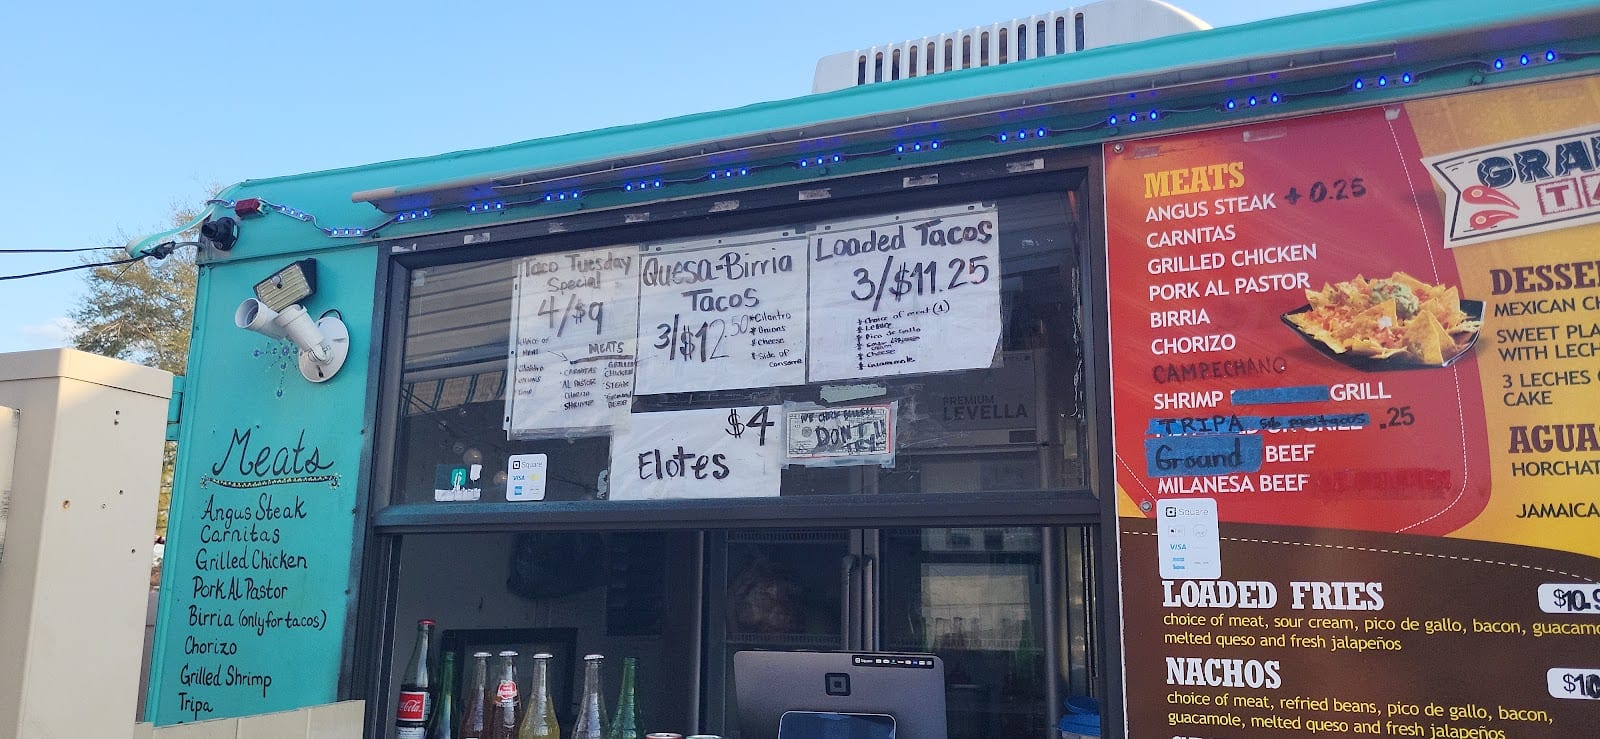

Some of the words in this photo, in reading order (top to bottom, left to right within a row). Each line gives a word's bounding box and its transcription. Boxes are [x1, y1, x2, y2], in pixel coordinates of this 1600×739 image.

[1144, 161, 1245, 198] MEATS
[1309, 178, 1367, 204] 0.25
[1145, 201, 1209, 223] ANGUS
[1214, 192, 1277, 215] STEAK
[816, 225, 906, 262] Loaded
[912, 218, 992, 247] Tacos
[1146, 224, 1236, 249] CARNITAS
[521, 257, 559, 277] Taco
[564, 252, 631, 275] Tuesday
[643, 248, 793, 287] Quesa-Birria
[1147, 252, 1225, 275] GRILLED
[1231, 243, 1318, 267] CHICKEN
[547, 271, 601, 295] Special
[851, 255, 990, 312] 3/$11.25
[1149, 281, 1201, 302] PORK
[1204, 278, 1230, 298] AL
[1235, 272, 1311, 294] PASTOR
[1490, 260, 1600, 296] DESSE
[680, 288, 760, 312] Tacos
[1494, 297, 1576, 318] MEXICAN
[538, 293, 605, 338] 4/$9
[1150, 308, 1210, 329] BIRRIA
[1151, 333, 1236, 355] CHORIZO
[1496, 325, 1560, 344] SWEET
[588, 341, 625, 355] MEATS
[1498, 346, 1549, 363] WITH
[1153, 356, 1287, 384] CAMPECHANO
[1502, 374, 1513, 389] 3
[1520, 370, 1591, 388] LECHES
[1153, 391, 1224, 410] SHRIMP
[1329, 381, 1392, 402] GRILL
[1503, 390, 1553, 407] CAKE
[943, 404, 1028, 420] LEVELLA
[1157, 414, 1244, 434] TRIPA
[725, 406, 775, 447] $4
[1508, 423, 1600, 454] AGUA
[212, 428, 334, 477] Meats
[638, 446, 730, 480] Elotes
[1156, 437, 1244, 471] Ground
[1265, 444, 1316, 463] BEEF
[1157, 474, 1255, 494] MILANESA
[1259, 473, 1310, 493] BEEF
[201, 494, 251, 529] Angus
[255, 492, 307, 520] Steak
[1178, 508, 1209, 517] Square
[1516, 501, 1600, 519] JAMAICA
[200, 523, 280, 544] Carnitas
[195, 546, 250, 571] Grilled
[252, 548, 308, 570] Chicken
[1170, 543, 1187, 551] VISA
[192, 575, 226, 599] Pork
[228, 576, 243, 600] Al
[245, 577, 288, 600] Pastor
[1161, 580, 1278, 609] LOADED
[1290, 581, 1385, 611] FRIES
[189, 605, 234, 627] Birria
[1163, 613, 1206, 627] choice
[1210, 613, 1225, 626] of
[1229, 615, 1269, 629] meat,
[1274, 617, 1302, 628] sour
[1308, 618, 1359, 632] cream,
[1364, 618, 1396, 632] pico
[1400, 617, 1420, 631] de
[1424, 618, 1467, 635] gallo,
[1473, 619, 1526, 636] bacon,
[185, 635, 237, 656] Chorizo
[1164, 632, 1212, 646] melted
[1215, 634, 1256, 649] queso
[1260, 634, 1286, 647] and
[1290, 634, 1326, 649] fresh
[1331, 635, 1402, 652] jalapeños
[180, 664, 222, 686] Grilled
[226, 665, 272, 698] Shrimp
[1166, 656, 1282, 689] NACHOS
[178, 692, 214, 720] Tripa
[1167, 691, 1211, 706] choice
[1214, 693, 1229, 706] of
[1233, 695, 1275, 711] meat,
[1280, 696, 1329, 711] refried
[1334, 698, 1382, 716] beans,
[1387, 701, 1420, 717] pico
[1424, 702, 1444, 717] de
[1449, 704, 1493, 721] gallo,
[1498, 706, 1554, 725] bacon,
[1168, 712, 1246, 729] guacamole,
[1251, 714, 1301, 730] melted
[1306, 718, 1349, 733] queso
[1353, 719, 1381, 734] and
[1386, 721, 1424, 737] fresh
[1430, 723, 1506, 739] jalapeños
